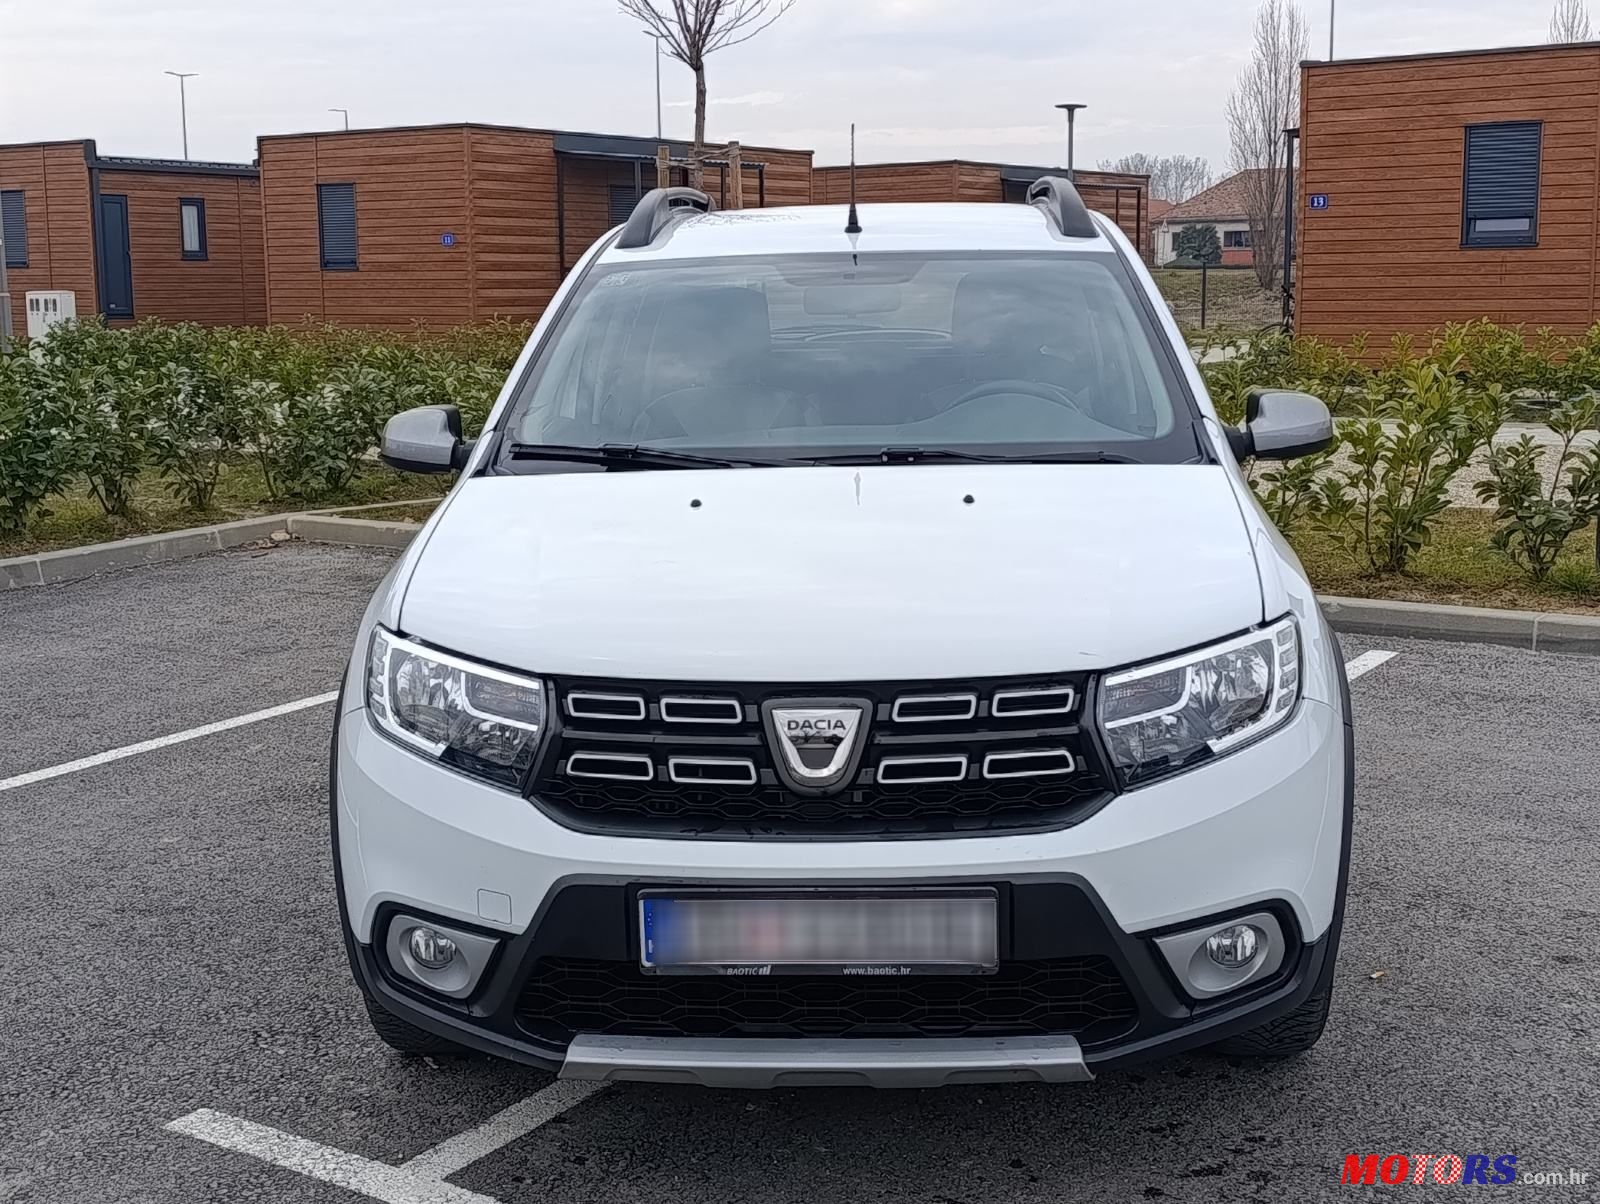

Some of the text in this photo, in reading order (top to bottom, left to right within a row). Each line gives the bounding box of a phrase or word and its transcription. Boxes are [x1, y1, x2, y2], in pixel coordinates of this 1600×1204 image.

[1313, 197, 1324, 207] 13
[787, 719, 846, 731] DACIA
[842, 965, 912, 976] www.baotic.hr
